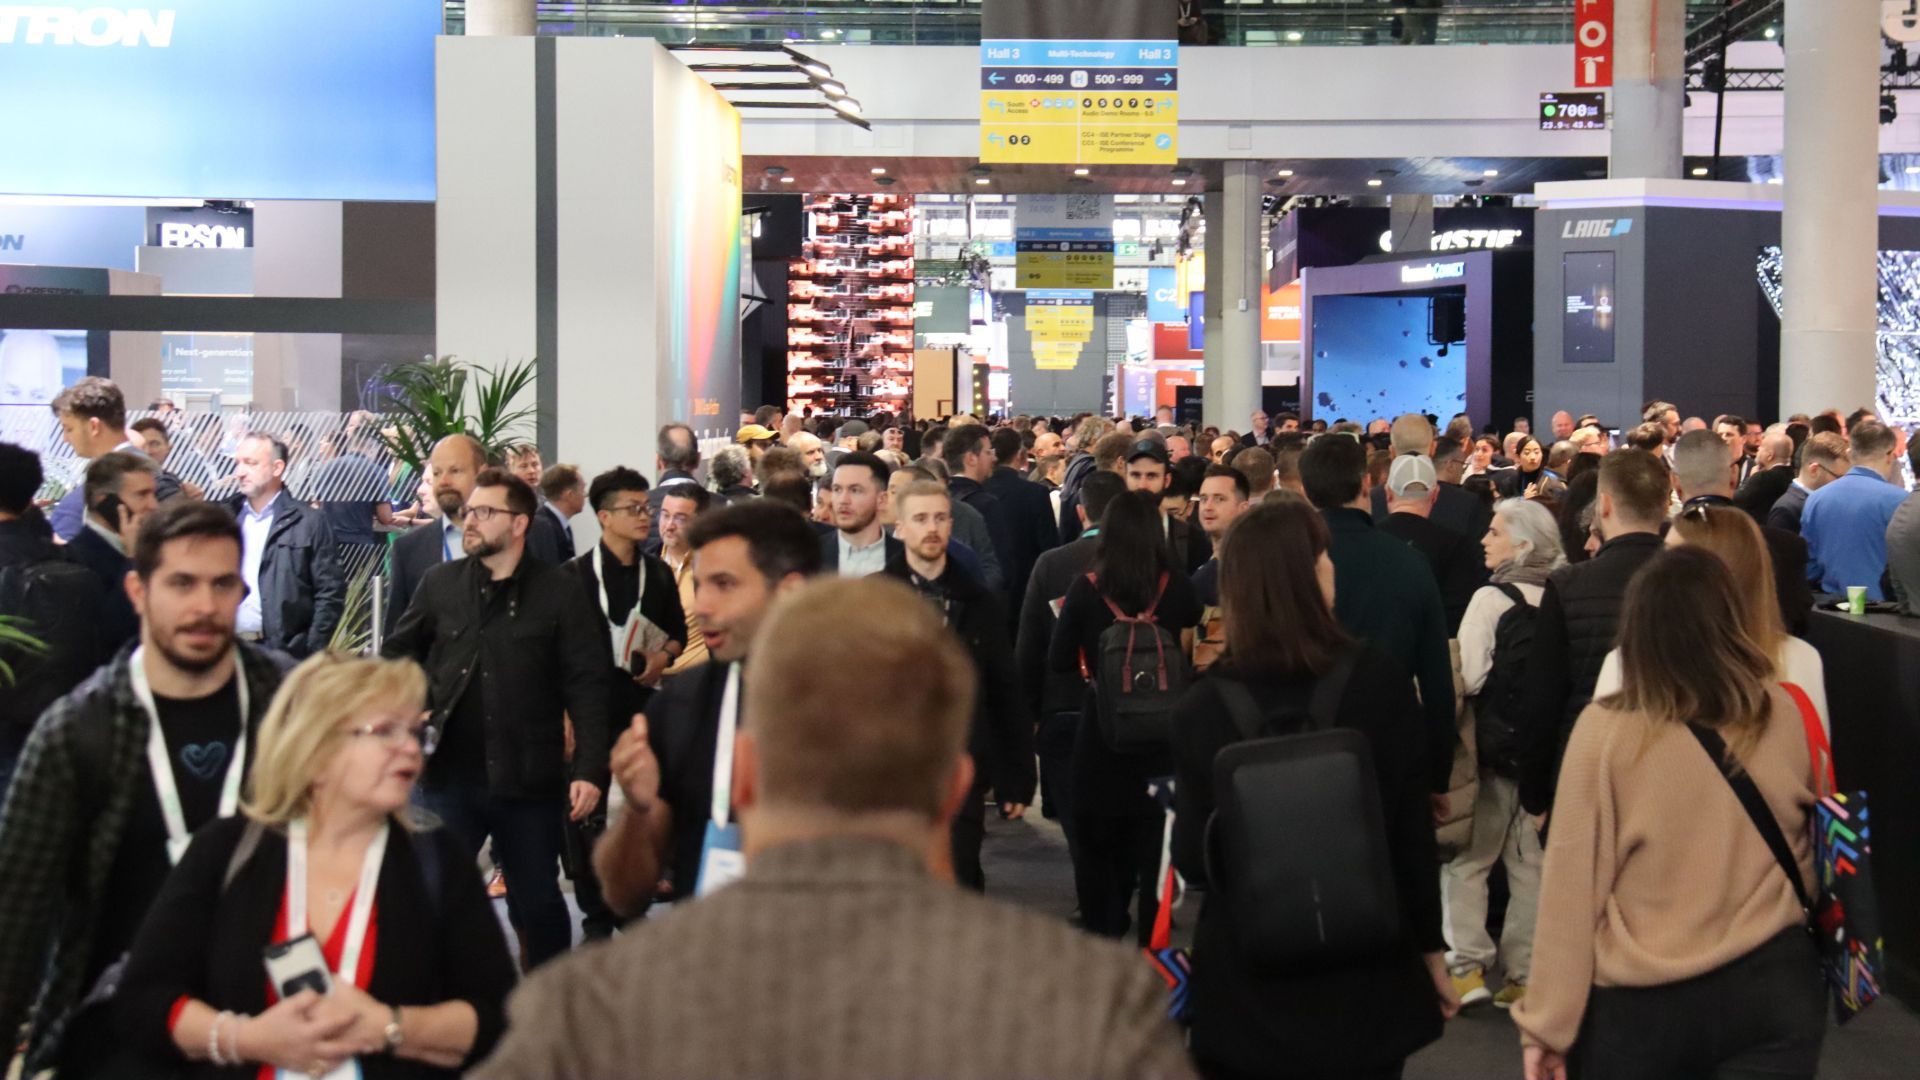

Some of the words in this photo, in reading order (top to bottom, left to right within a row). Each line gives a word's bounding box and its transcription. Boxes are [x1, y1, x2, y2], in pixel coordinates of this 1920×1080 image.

[987, 48, 1010, 58] Hall
[1012, 48, 1020, 58] 3
[1048, 50, 1115, 59] Multi-Technology
[1139, 48, 1161, 59] Hall
[1163, 48, 1171, 59] 3
[1015, 74, 1036, 83] 000
[1043, 74, 1064, 83] 499
[1095, 75, 1115, 84] 500
[1123, 75, 1144, 84] 999
[1558, 104, 1587, 117] 700
[1562, 219, 1614, 238] LANG
[161, 223, 245, 248] EPSON
[175, 348, 254, 358] Next-generation
